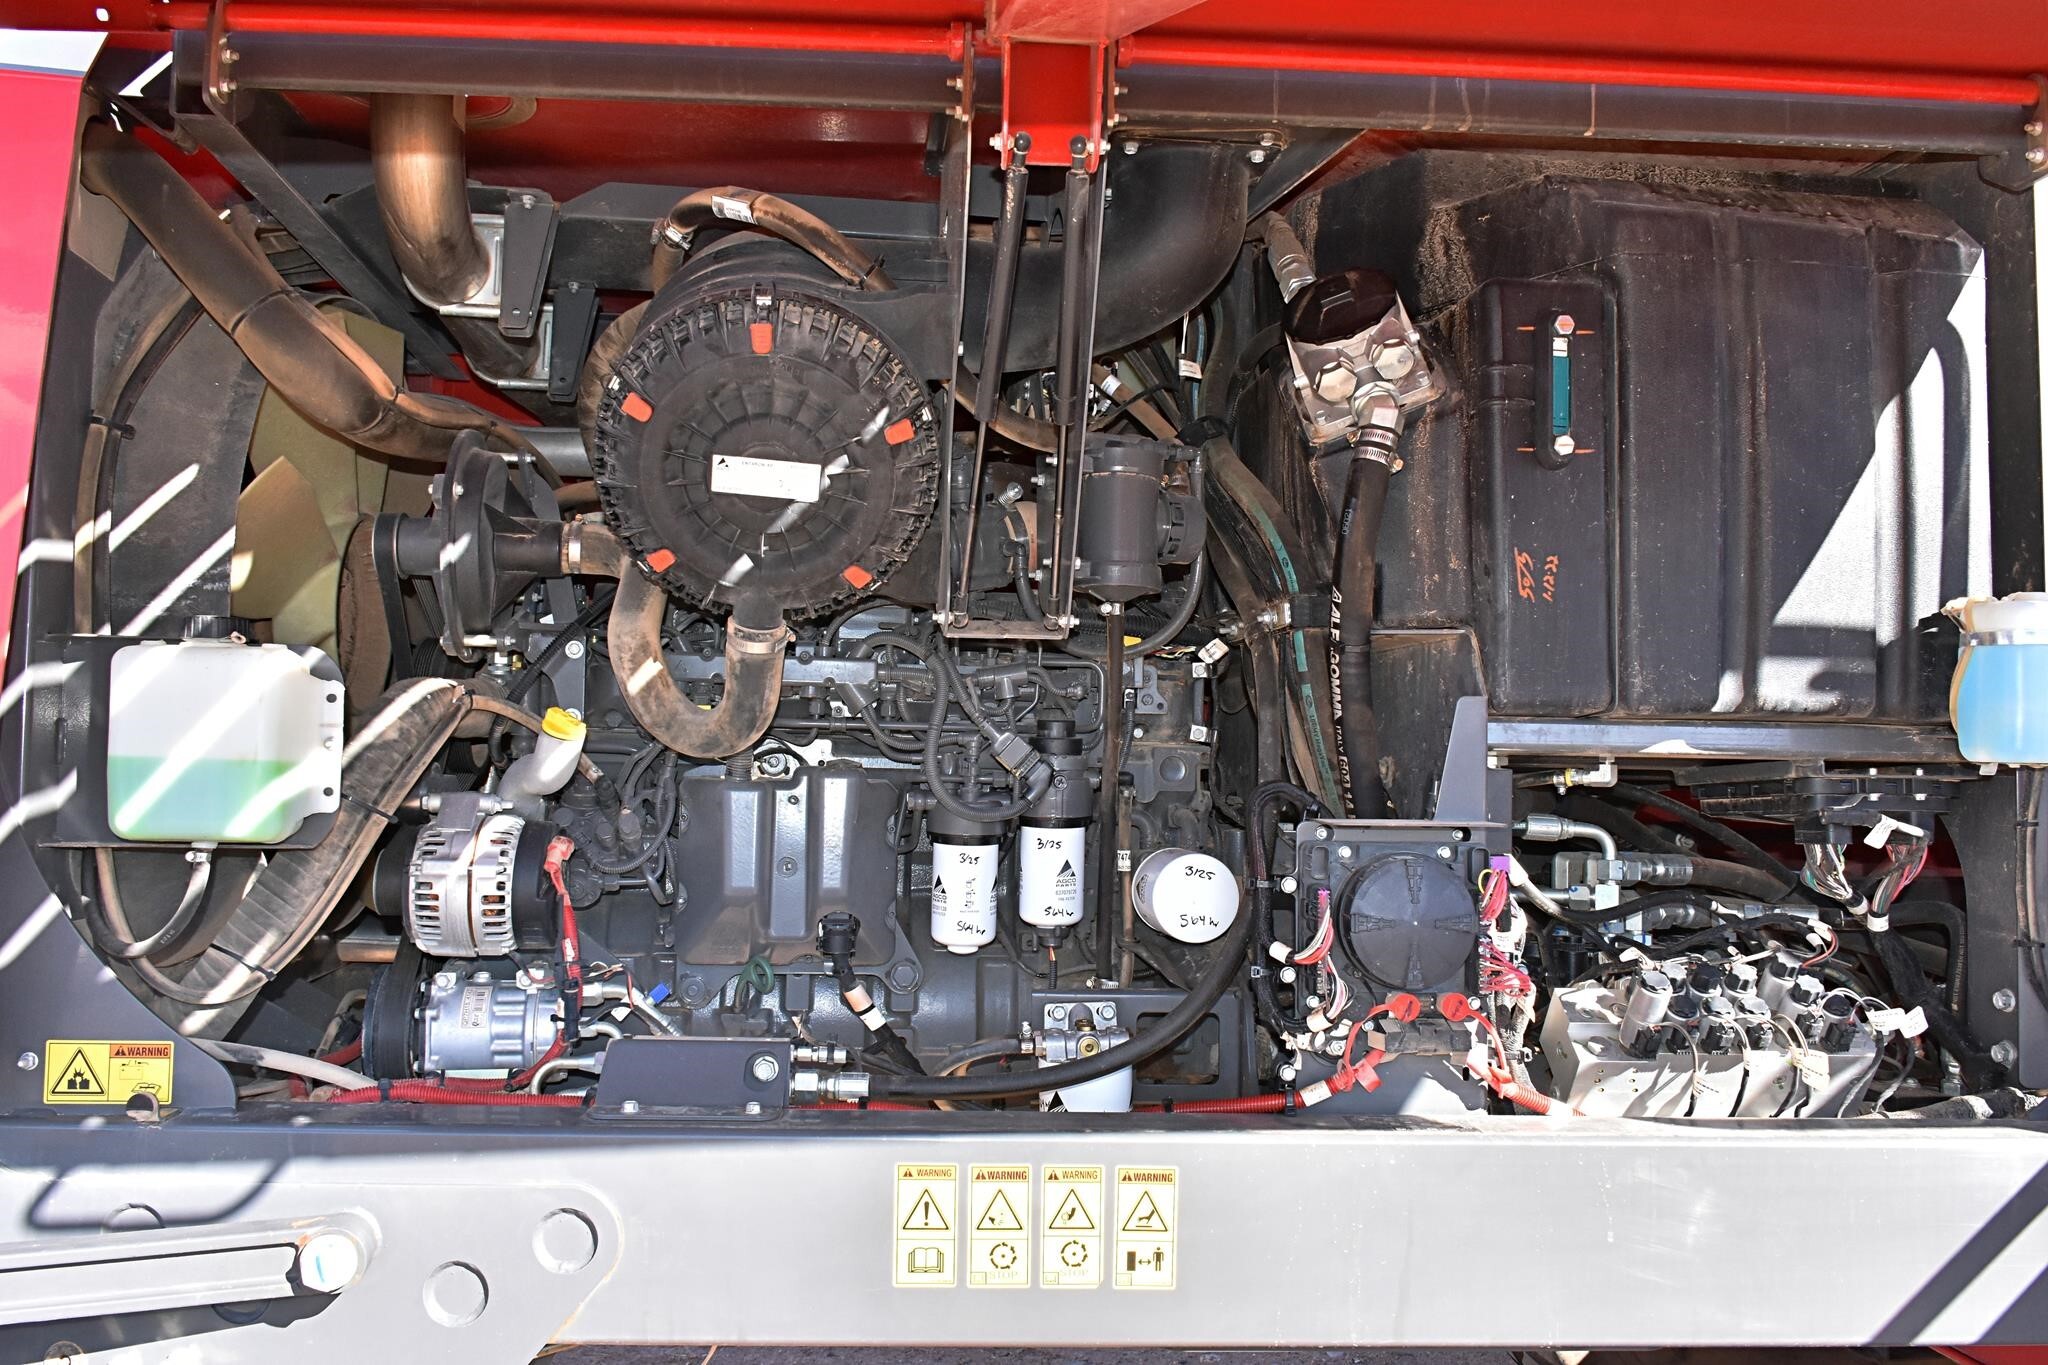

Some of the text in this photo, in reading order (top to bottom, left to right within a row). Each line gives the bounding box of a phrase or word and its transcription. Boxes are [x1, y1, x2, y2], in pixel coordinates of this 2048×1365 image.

[127, 1047, 169, 1057] WARNING
[916, 1168, 952, 1178] WARNING
[987, 1170, 1028, 1181] WARNING
[1062, 1170, 1098, 1180] WARNING
[1133, 1172, 1173, 1183] WARNING
